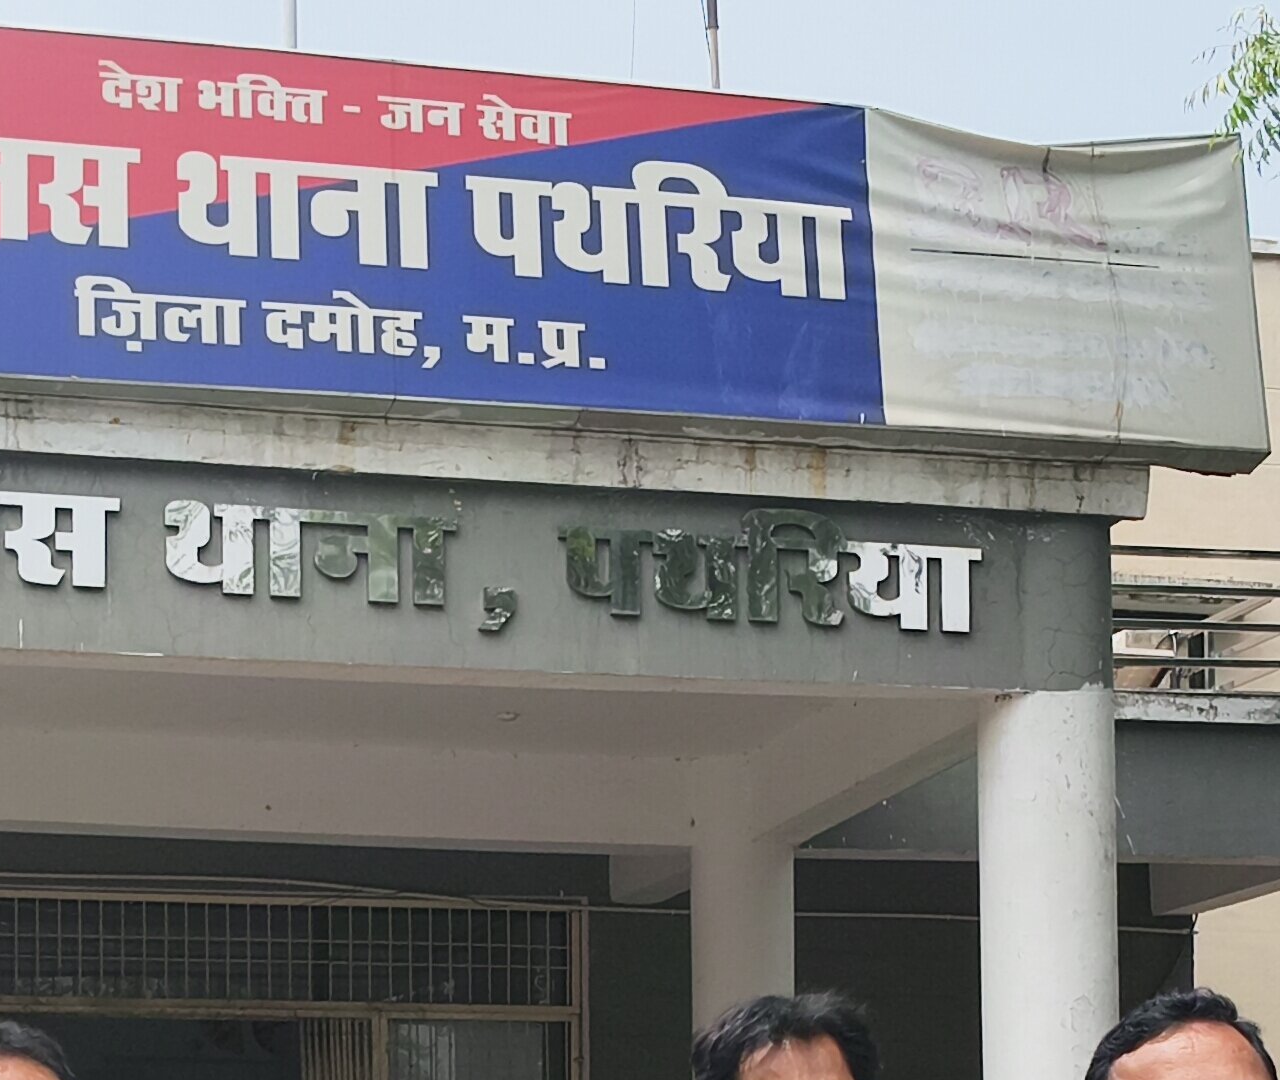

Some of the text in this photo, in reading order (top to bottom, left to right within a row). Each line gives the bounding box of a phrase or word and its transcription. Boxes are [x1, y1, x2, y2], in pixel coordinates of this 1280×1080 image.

[98, 60, 183, 113] देश
[198, 73, 328, 125] भक्ति
[377, 95, 465, 137] जन
[476, 93, 572, 147] सेवा
[176, 150, 439, 270] थाना
[465, 160, 852, 301] पथरिया
[261, 290, 442, 370] दमोह,
[462, 314, 607, 370] म.प्र.
[558, 507, 983, 634] पथरिया
